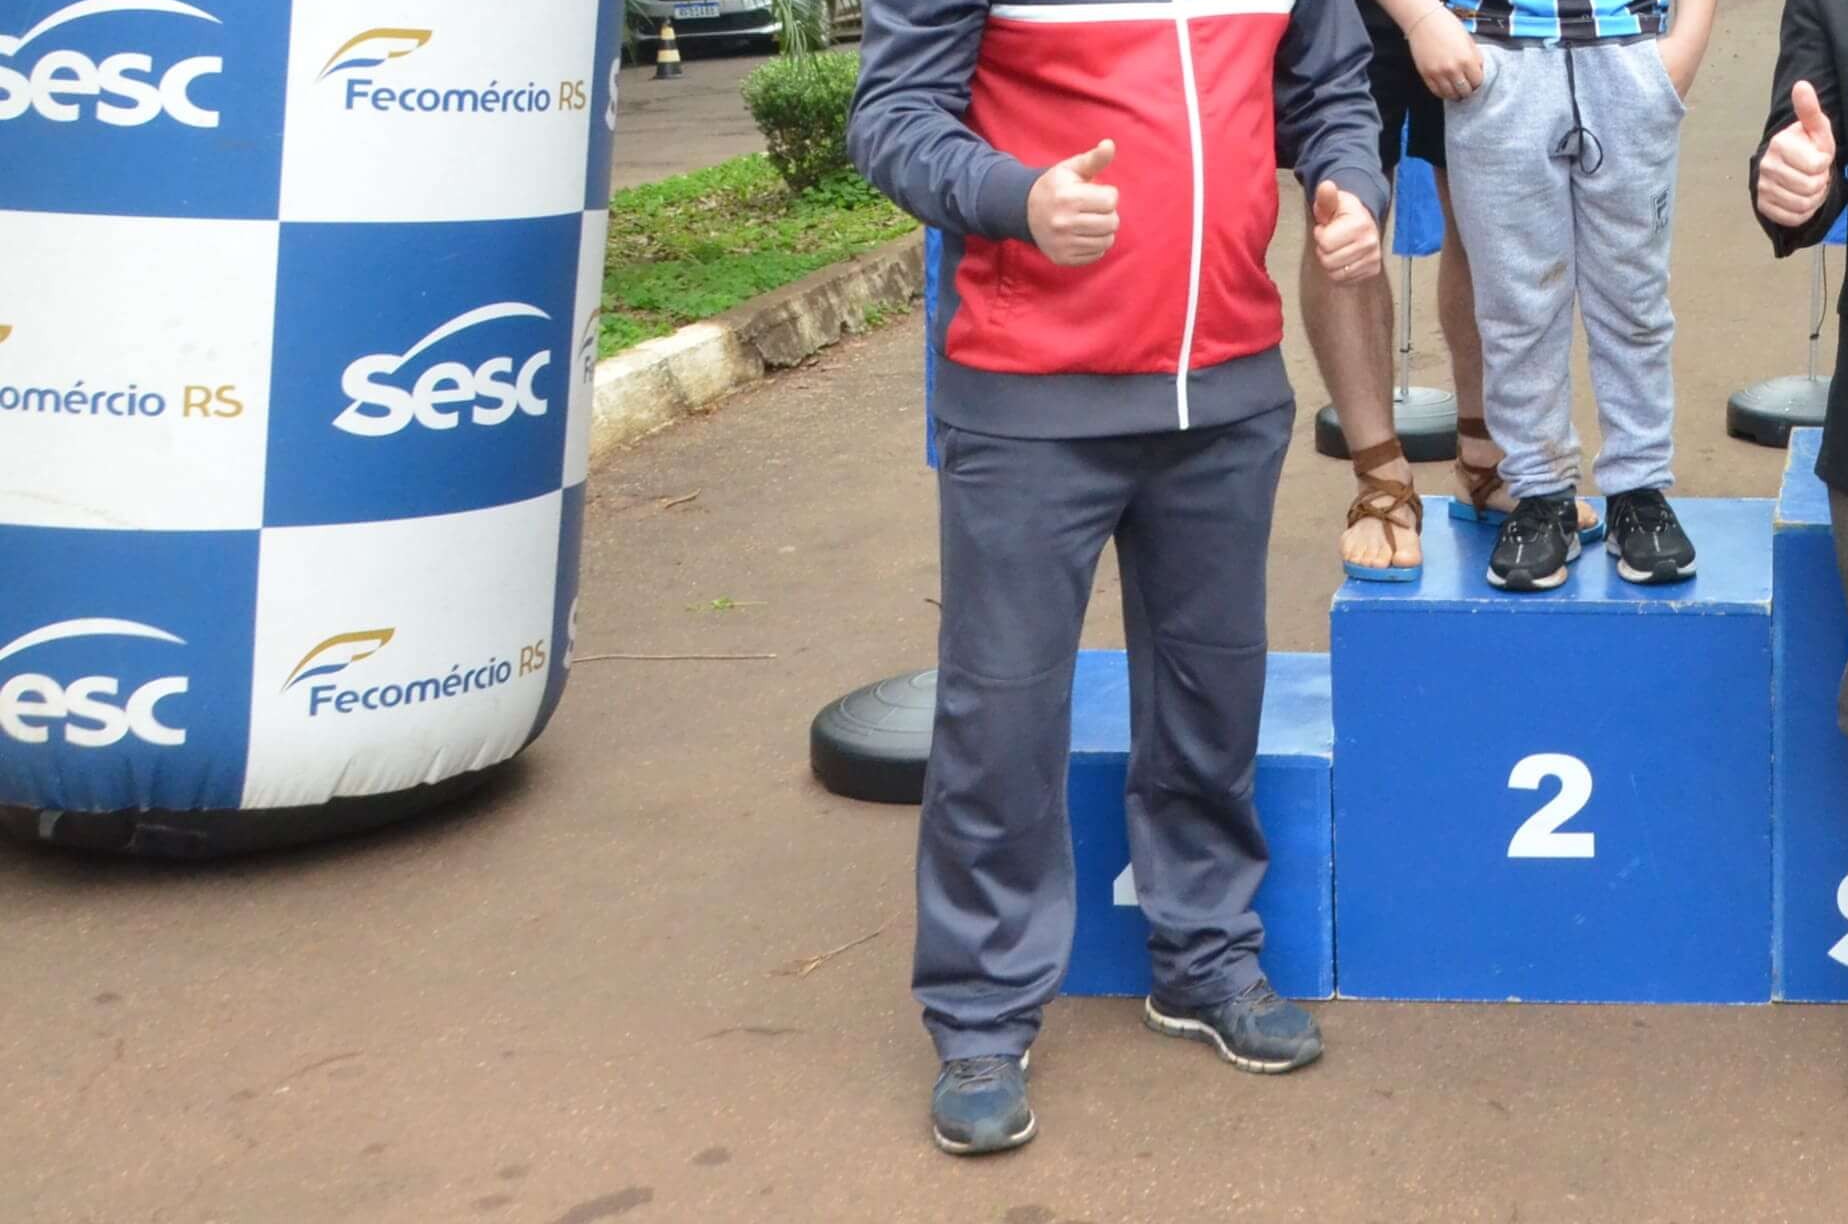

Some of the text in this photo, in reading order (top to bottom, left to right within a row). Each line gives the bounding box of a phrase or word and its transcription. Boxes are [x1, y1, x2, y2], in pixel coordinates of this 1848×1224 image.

[344, 78, 551, 114] Fecomércio
[559, 80, 587, 112] RS
[0, 379, 244, 419] omércio RS
[0, 672, 189, 748] esc
[309, 641, 546, 716] Fecomércio RS
[1506, 752, 1595, 859] 2
